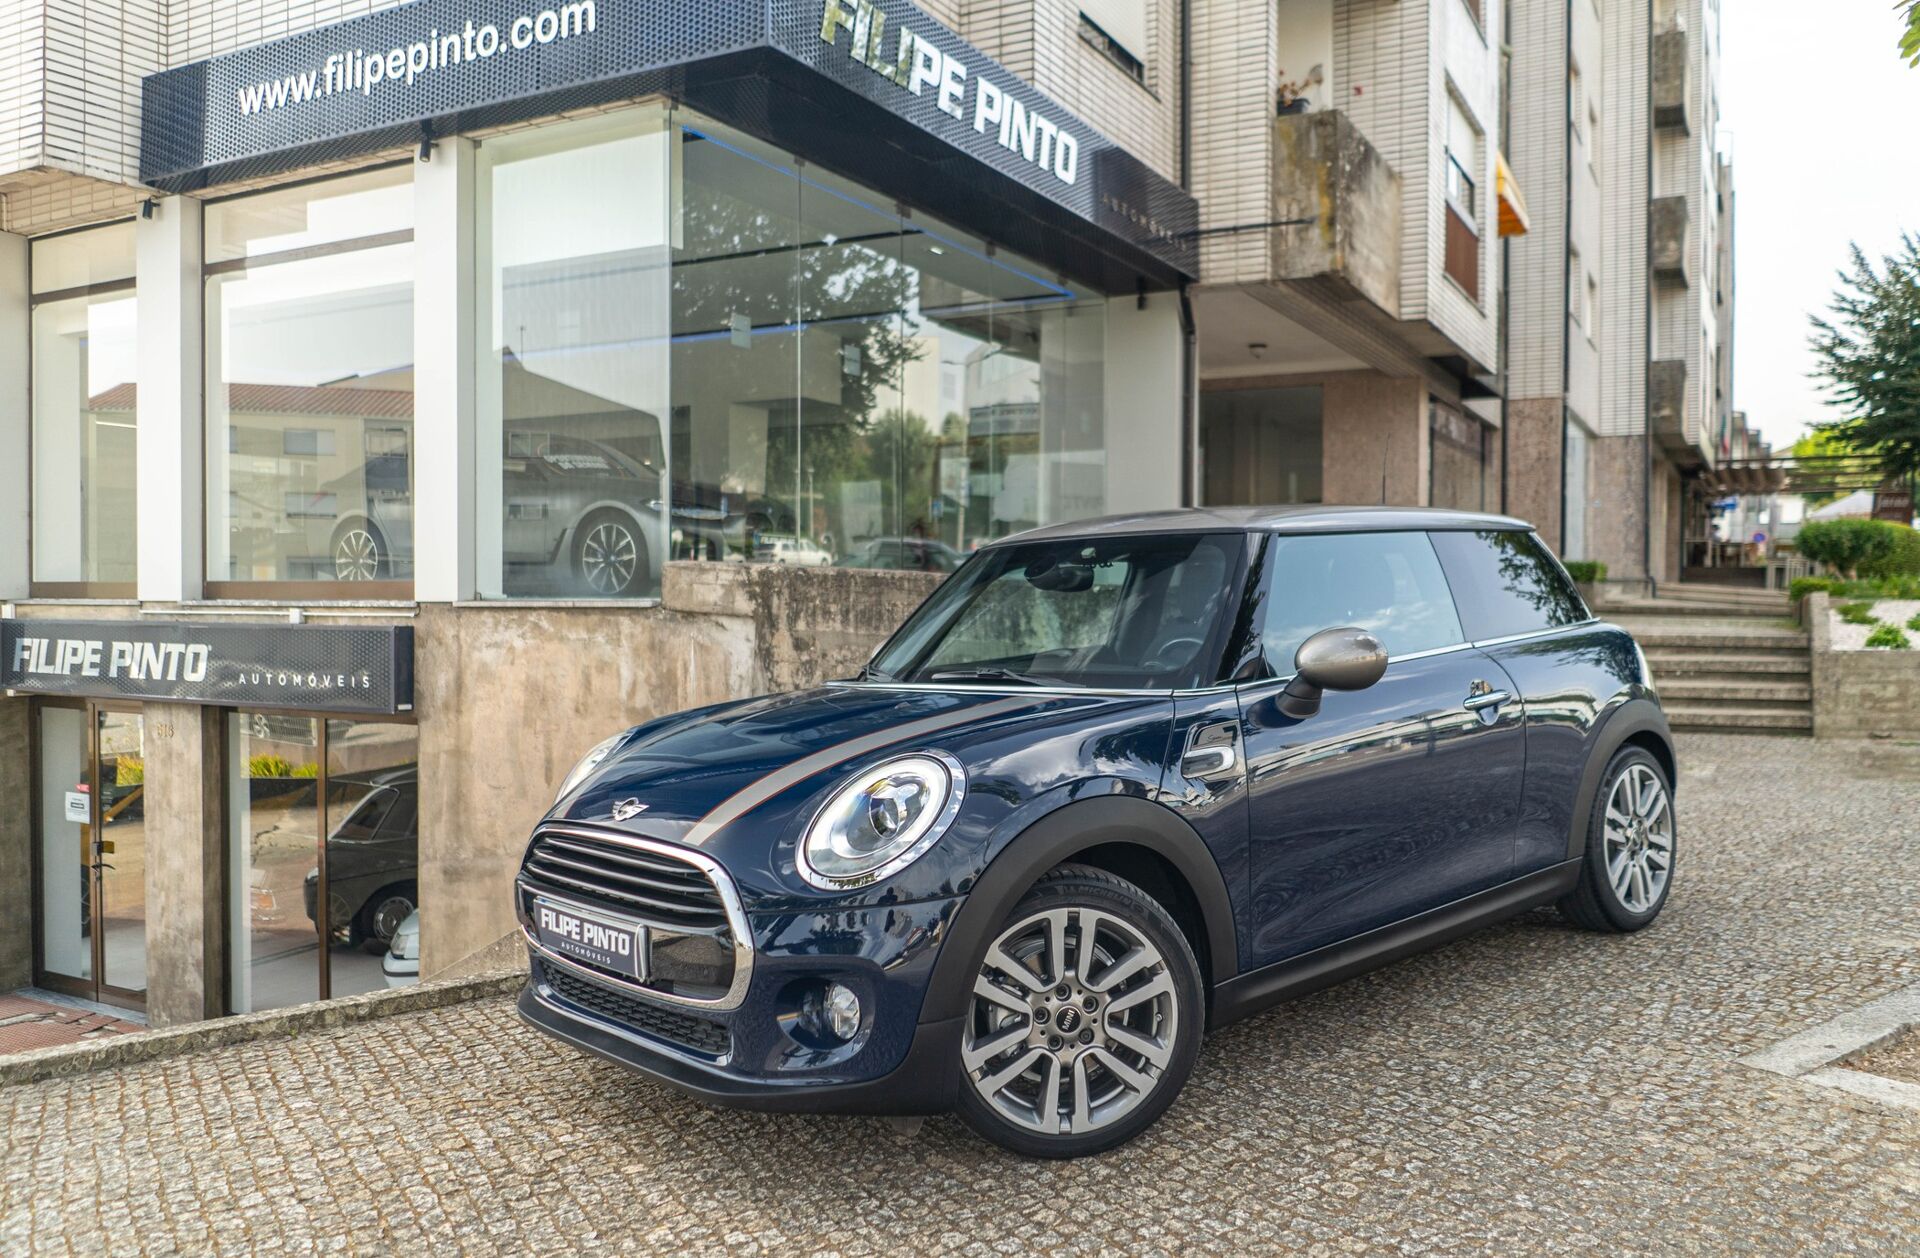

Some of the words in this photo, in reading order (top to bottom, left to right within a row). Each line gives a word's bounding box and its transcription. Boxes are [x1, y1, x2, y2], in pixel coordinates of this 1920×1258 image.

[239, 0, 596, 116] www.filipepinto.com
[819, 0, 967, 121] FILIPE
[973, 76, 1078, 186] PINTO
[13, 638, 103, 676] FILIPE
[109, 641, 209, 682] PINTO
[238, 672, 369, 688] AUTOMÓVEIS
[541, 908, 581, 941] FILIPE
[583, 922, 630, 956] PINTO
[561, 942, 611, 964] AUTOMÓVEIS
[1062, 1009, 1075, 1030] MINI
